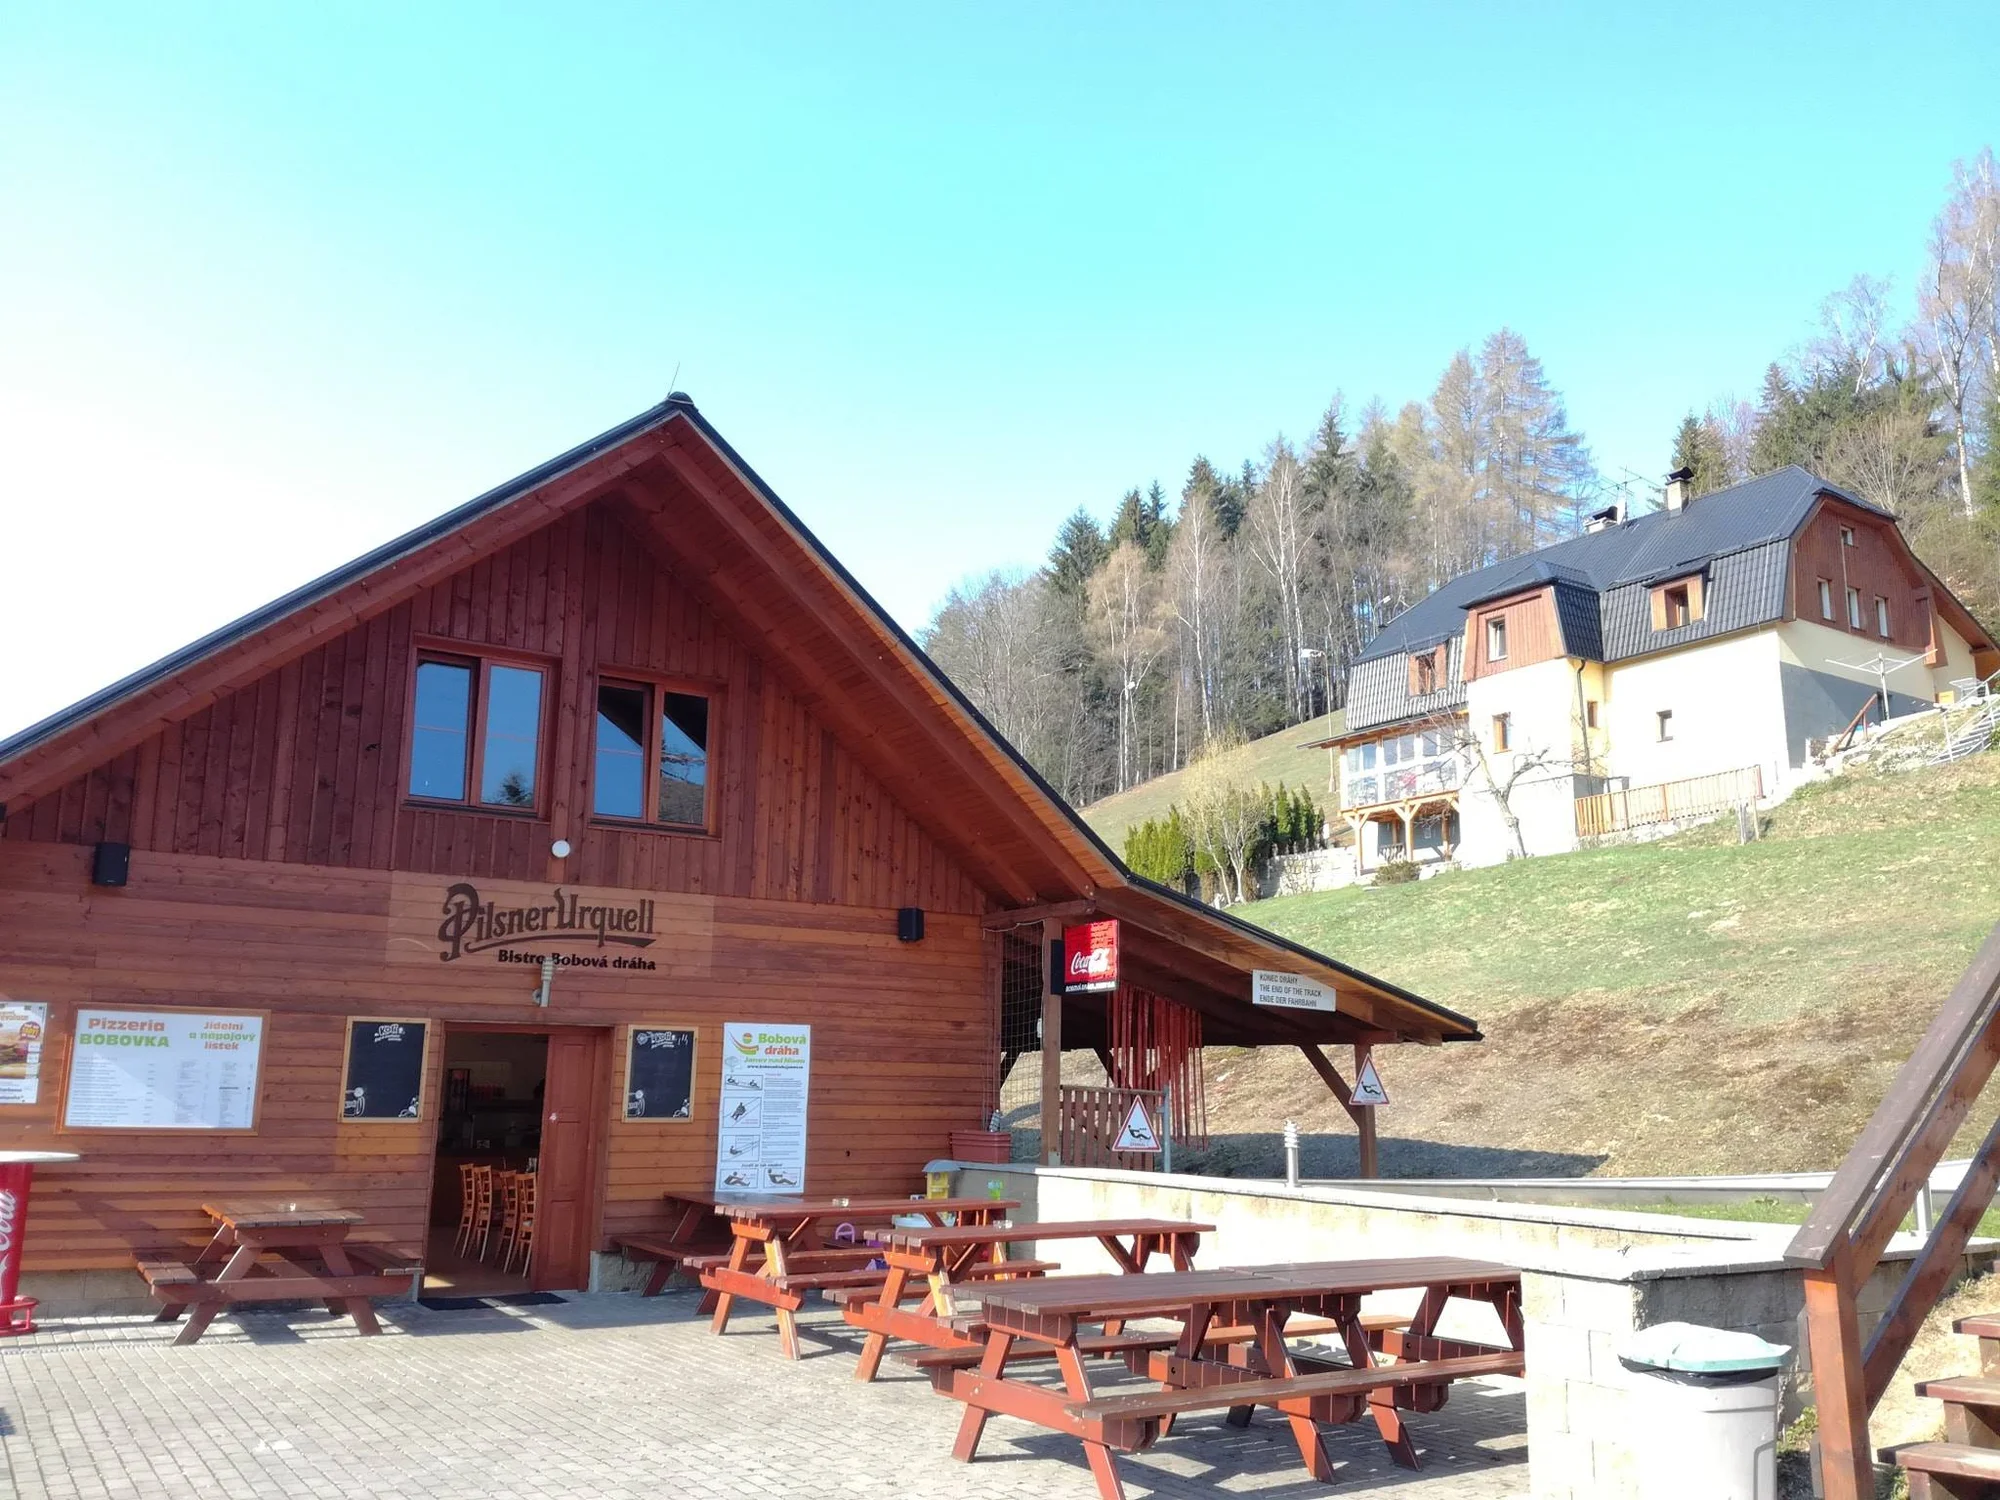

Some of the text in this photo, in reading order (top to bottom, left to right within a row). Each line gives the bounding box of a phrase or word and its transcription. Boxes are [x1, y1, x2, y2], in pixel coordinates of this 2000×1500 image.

[438, 883, 655, 962] Pilsner Urquell
[498, 950, 656, 971] Bistro Bobová dráha
[1260, 974, 1298, 984] KONEC DRÁHY
[1260, 984, 1322, 997] THE END OF THE TRACK
[1260, 994, 1317, 1007] ENDE DER FAHRBAHN
[87, 1017, 165, 1032] Pizzeria
[79, 1033, 170, 1047] BOBOVKA
[758, 1033, 807, 1045] Bobová
[764, 1045, 800, 1056] dráha
